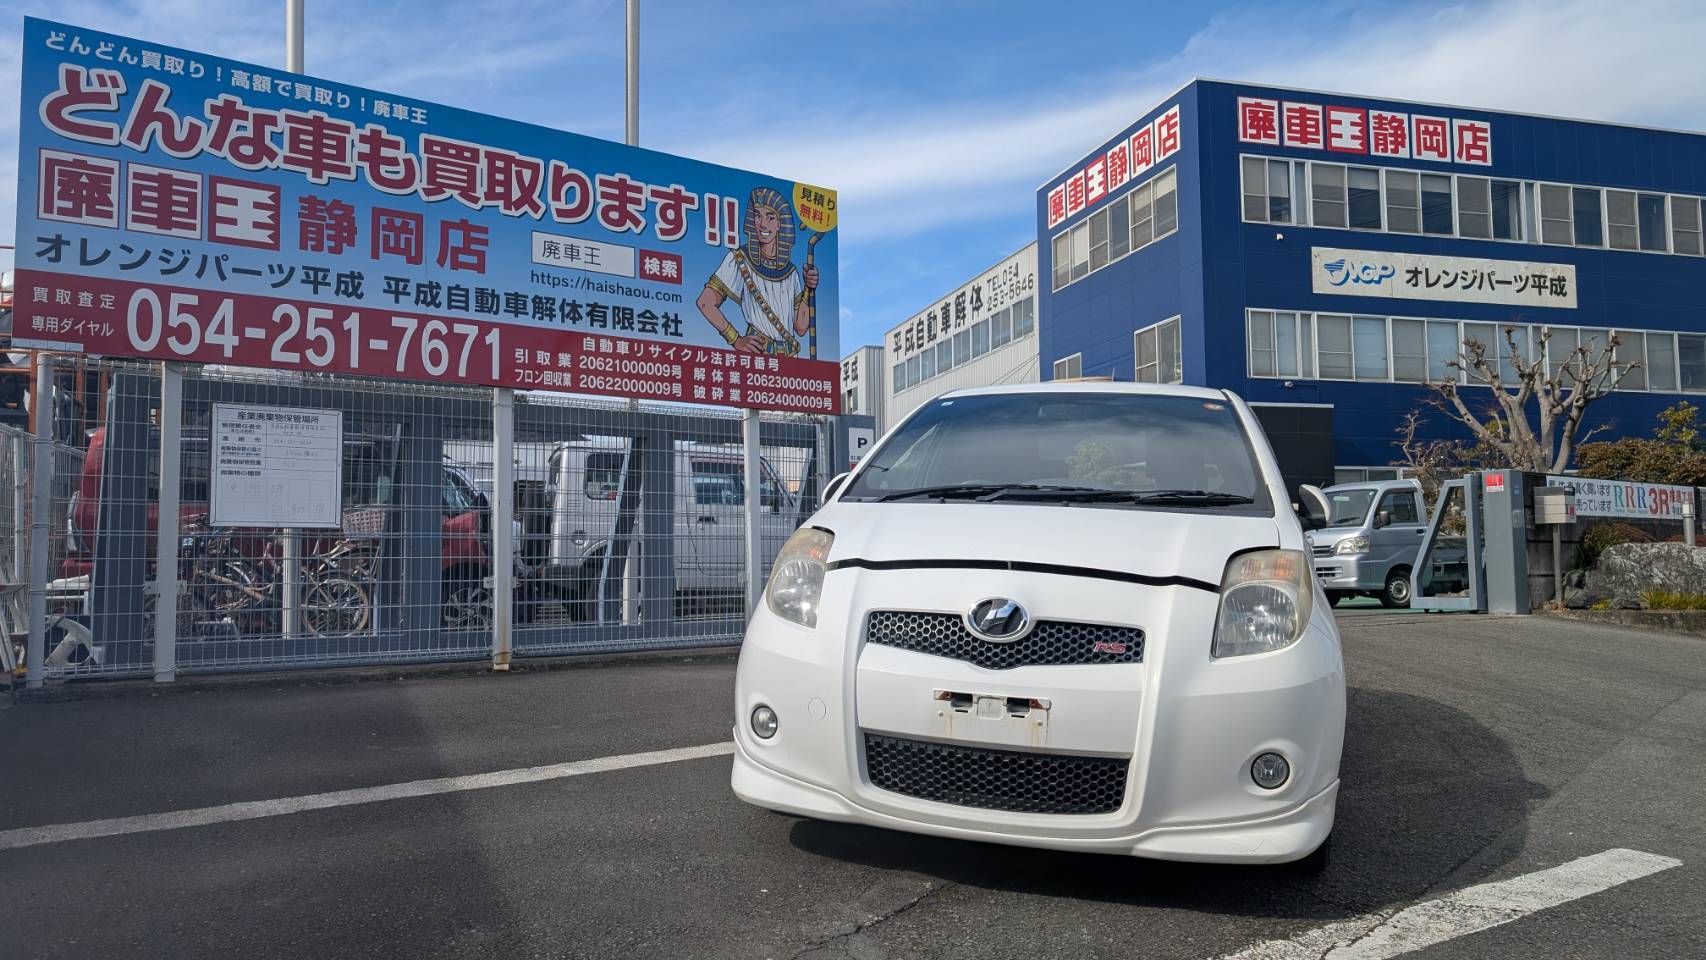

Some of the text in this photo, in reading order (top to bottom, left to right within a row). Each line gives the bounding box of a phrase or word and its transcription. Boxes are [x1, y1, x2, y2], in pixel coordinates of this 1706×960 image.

[800, 187, 836, 211] 見積り
[542, 240, 602, 267] 廃車王
[643, 256, 679, 279] 検索
[35, 234, 684, 338] オレンジパーツ平成 平成自動車解体有限会社
[531, 270, 684, 304] https://haishaou.com
[987, 273, 1034, 312] 253-5646
[1405, 265, 1568, 298] オレンジパーツ平成
[32, 286, 116, 311] 買取査定
[31, 315, 114, 338] 専用ダイヤル
[126, 288, 500, 381] 054-251-7671
[892, 282, 984, 361] 平成自動車解体
[514, 347, 833, 394] 引取業 20621000009号 解体業 20623000009号
[582, 336, 780, 372] 自動車リサイクル法許可番号
[843, 355, 859, 388] 平成
[514, 368, 833, 411] フロン回収業 20622000009号 破砕業 20624000009号
[857, 437, 868, 448] P
[1093, 641, 1126, 654] RS
